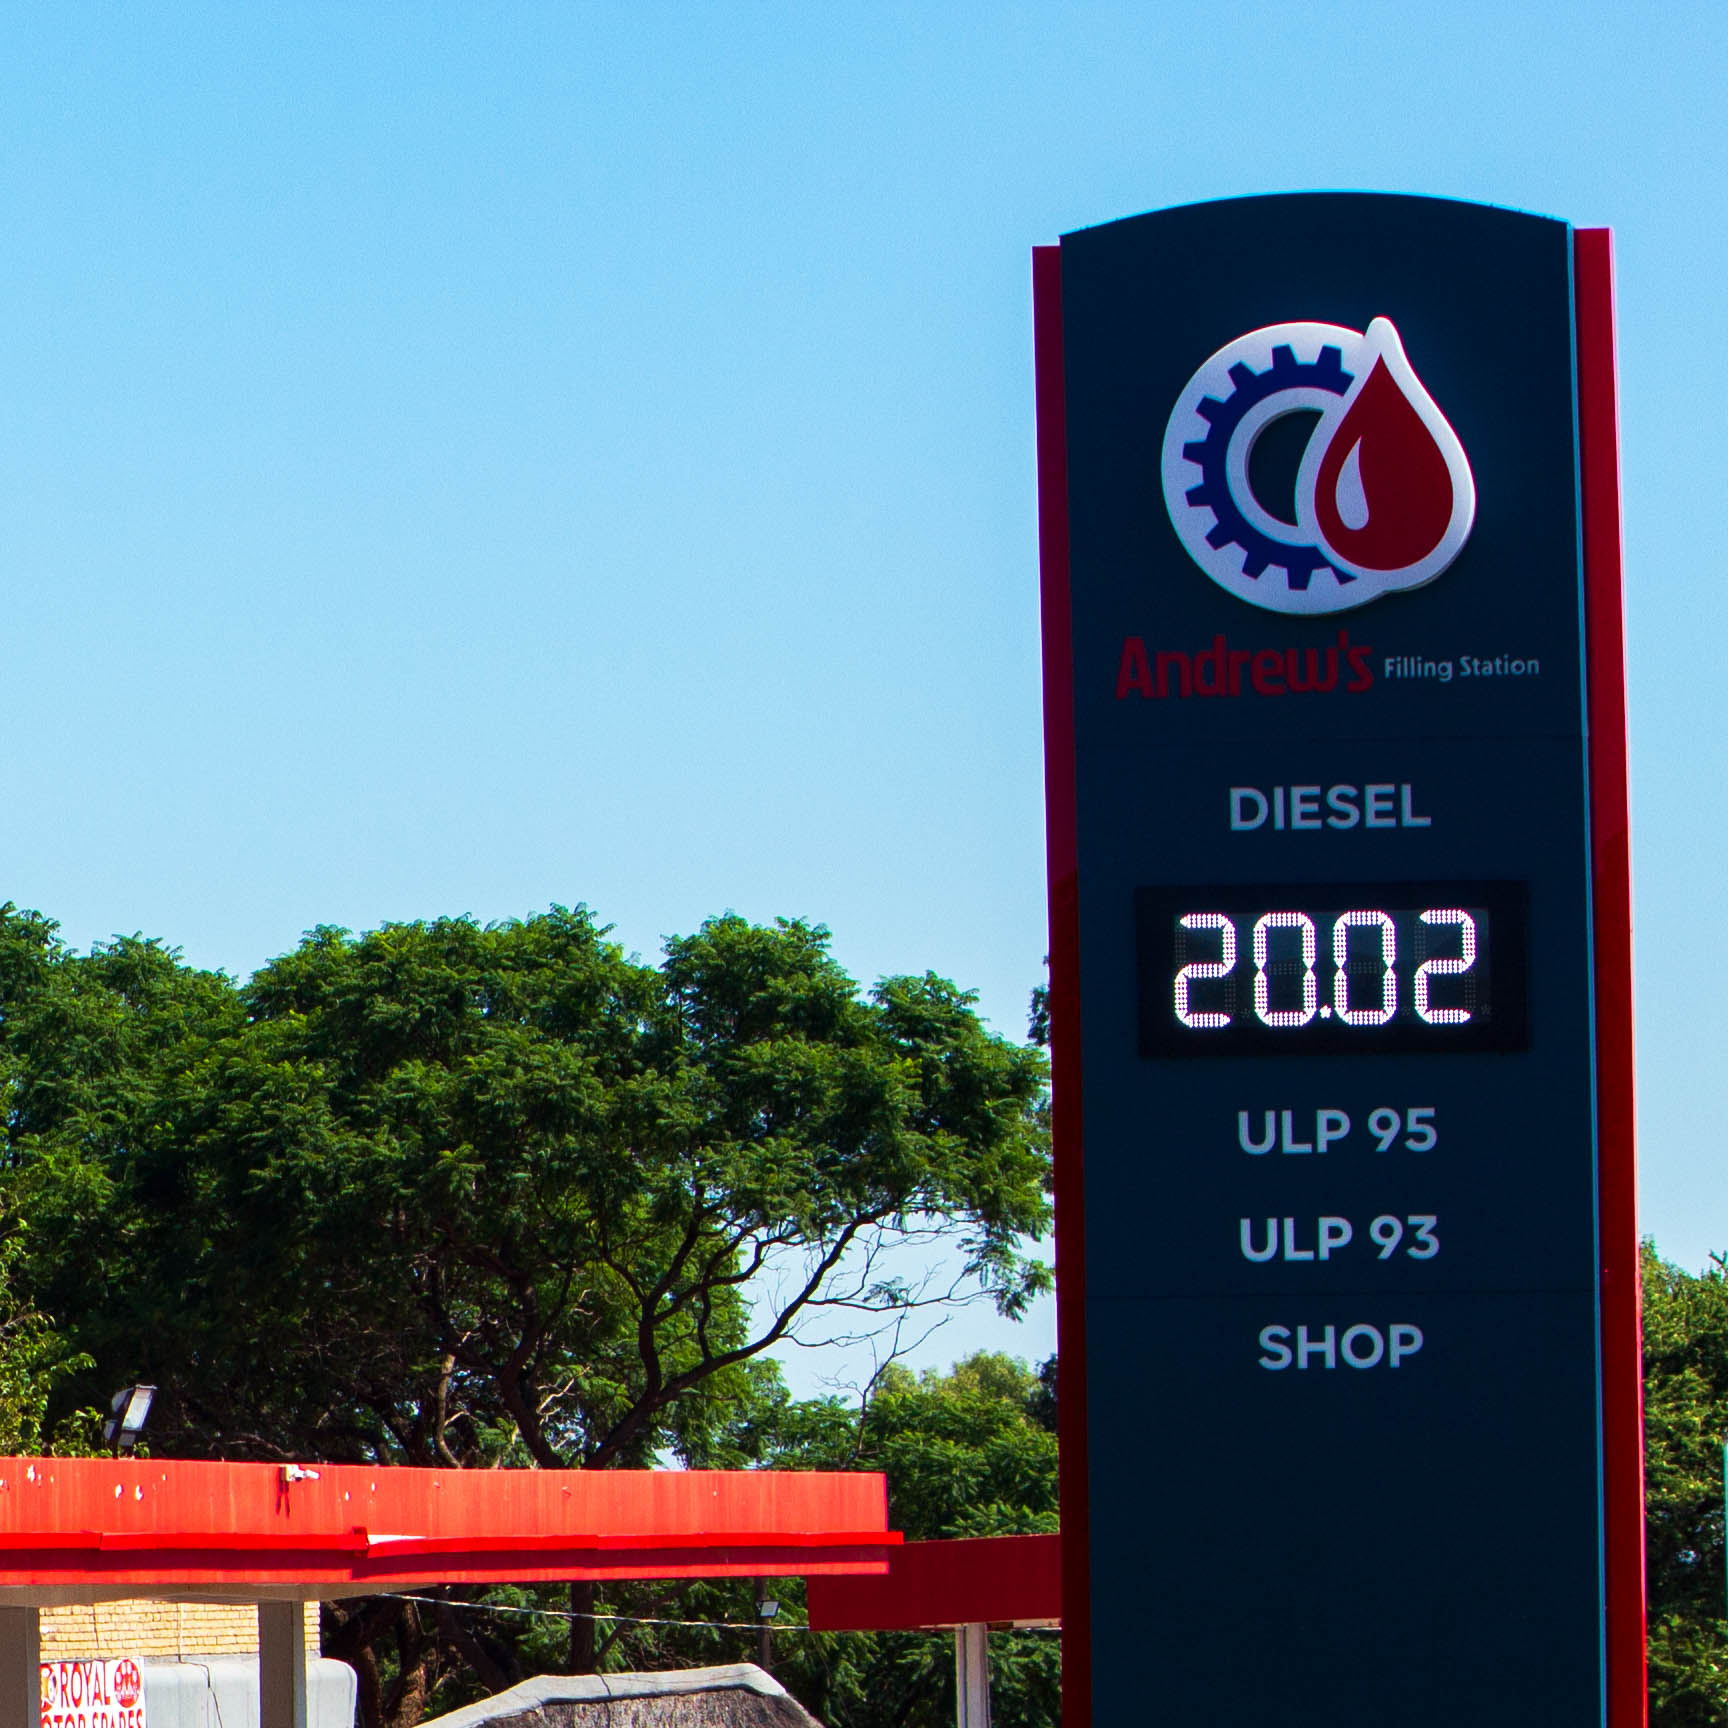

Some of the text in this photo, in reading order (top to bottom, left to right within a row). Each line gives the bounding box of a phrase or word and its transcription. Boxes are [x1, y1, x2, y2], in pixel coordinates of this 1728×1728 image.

[1116, 630, 1540, 699] Andrew's Filling Station
[1230, 783, 1432, 831] DIESEL
[1175, 909, 1476, 1028] 20.02
[1238, 1106, 1438, 1155] ULP 95
[1240, 1214, 1440, 1262] ULP 93
[1258, 1323, 1424, 1371] SHOP
[59, 1661, 111, 1708] ROYAL
